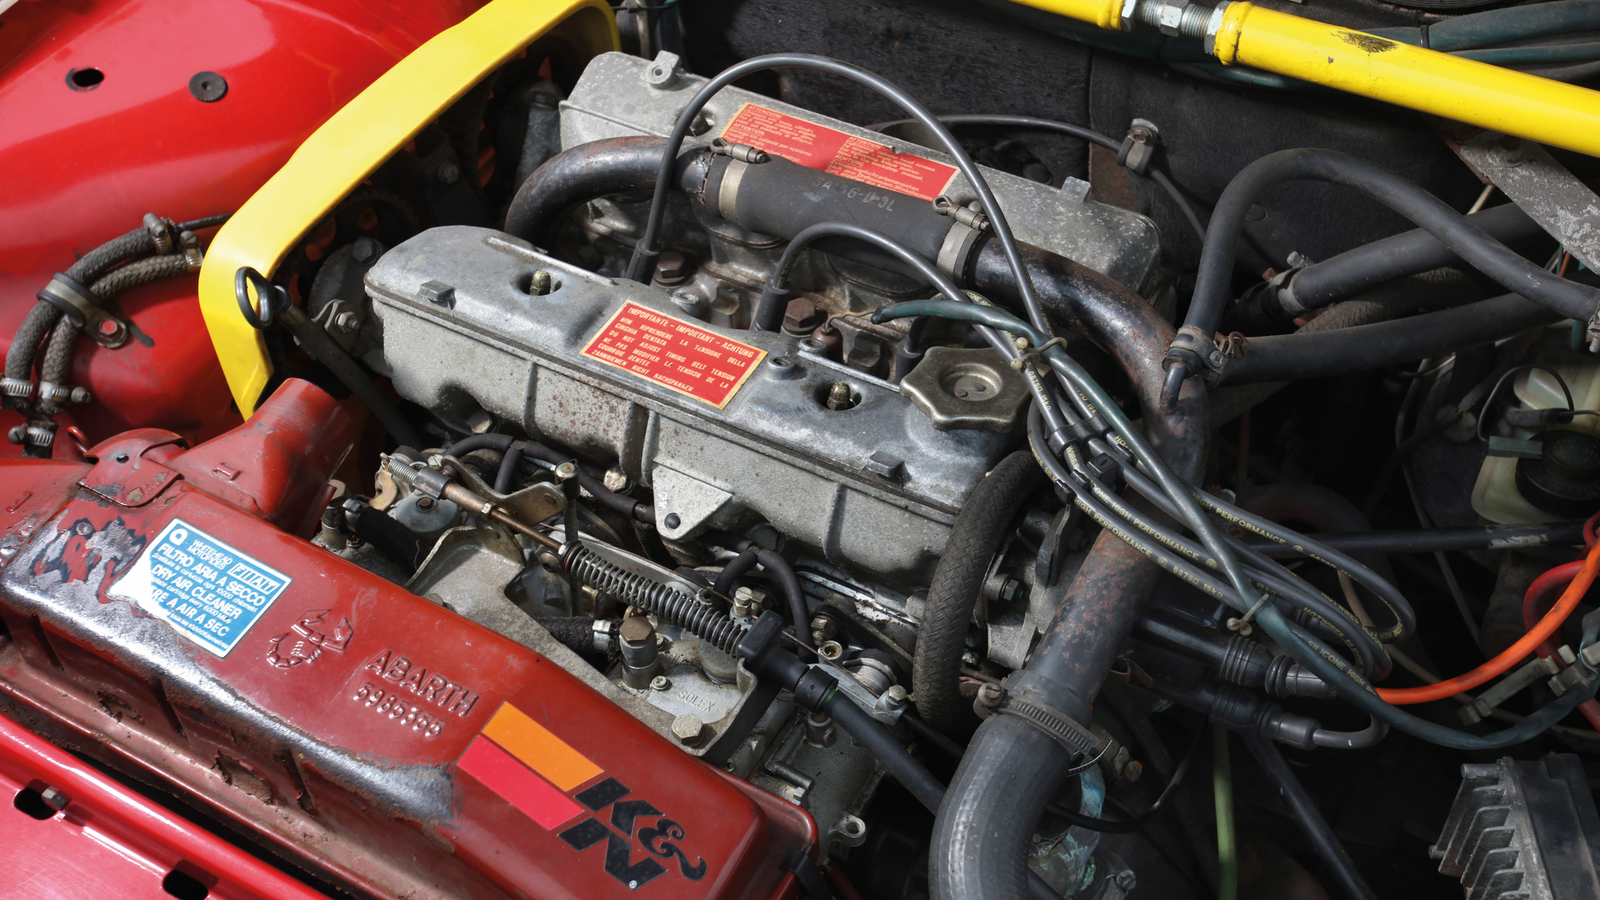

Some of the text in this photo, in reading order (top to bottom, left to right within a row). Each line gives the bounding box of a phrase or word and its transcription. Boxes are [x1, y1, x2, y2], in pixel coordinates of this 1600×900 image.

[732, 122, 765, 135] ATTENTION
[752, 115, 773, 124] sistema
[752, 119, 778, 130] serraggio
[778, 127, 799, 137] seguire
[759, 125, 783, 135] manuale
[794, 124, 813, 133] cilindri
[727, 127, 749, 137] Serrage
[758, 136, 779, 145] culasse
[848, 136, 881, 149] ATTENTION
[834, 154, 864, 166] ACHTUNG
[843, 140, 935, 171] Tightening cylinder head screws
[870, 161, 898, 173] workshop
[880, 159, 898, 167] follow
[615, 323, 667, 346] CINGHIA DENTATA
[620, 317, 633, 325] NON
[639, 324, 674, 340] RIPRENDERE
[694, 344, 722, 359] TENSIONE
[727, 357, 745, 368] DELLA
[627, 307, 669, 327] IMPORTANTE
[675, 325, 715, 343] IMPORTANT
[721, 342, 754, 358] ACHTUNG
[598, 343, 650, 367] COURROIE DENTEE
[615, 342, 628, 350] PAS
[632, 349, 660, 362] MODIFIER
[676, 365, 702, 378] TENSION
[622, 335, 635, 343] NOT
[639, 342, 661, 353] ADJUST
[666, 351, 686, 362] TIMING
[691, 361, 707, 370] BELT
[711, 368, 736, 381] TENSION
[591, 350, 694, 392] ZAHNRIEMEN NICHT NACHSPANNEN
[1074, 496, 1092, 515] HIGH
[1093, 514, 1152, 558] PERFORMANCE
[1111, 502, 1132, 520] HIGH
[1133, 518, 1199, 561] PERFORMANCE
[1215, 507, 1286, 545] PERFORMANCE
[187, 545, 226, 570] MOTOFIDES
[194, 540, 232, 565] WHITEHEAD
[157, 543, 266, 606] FILTRO ARIA A SECCO
[202, 581, 215, 590] ogni
[229, 562, 278, 594] FIAT
[150, 564, 175, 581] DRY
[171, 576, 193, 591] AIR
[189, 586, 242, 619] CLEANER
[165, 585, 190, 600] cartridge
[188, 598, 203, 608] every
[166, 597, 179, 607] A
[176, 603, 197, 618] AIR
[194, 613, 206, 623] A
[204, 619, 229, 636] SEC
[1307, 640, 1346, 671] SILICONE
[1346, 669, 1365, 686] HIGH
[364, 649, 478, 717] ABARTH
[677, 690, 715, 712] SOLEX
